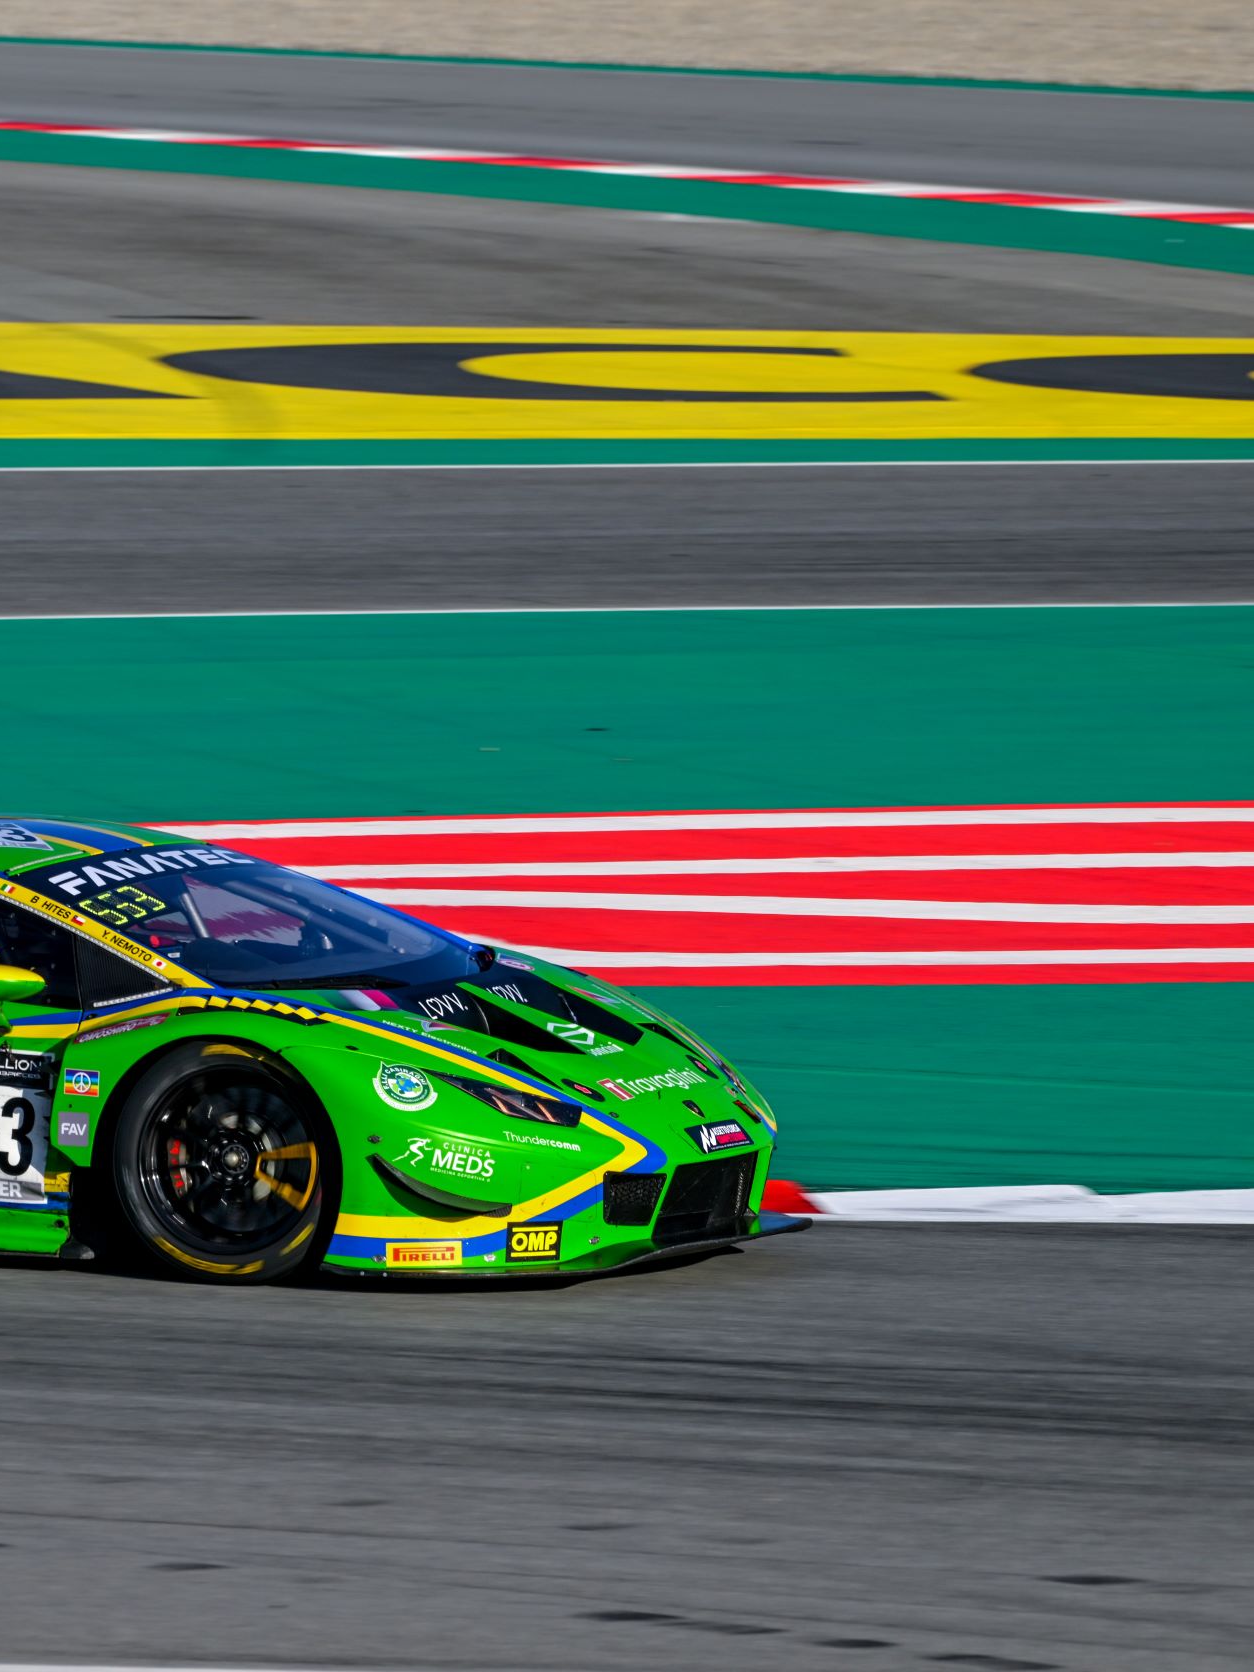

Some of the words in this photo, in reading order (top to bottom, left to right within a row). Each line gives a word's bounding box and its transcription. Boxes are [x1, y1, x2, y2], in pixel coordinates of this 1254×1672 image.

[48, 849, 256, 896] FANATEC
[41, 900, 72, 920] HITES
[101, 929, 112, 939] Y.
[111, 933, 153, 962] NEMOTO
[382, 1019, 419, 1034] NEXTY
[421, 1031, 478, 1055] Electronics
[615, 1067, 707, 1095] Travaglini
[60, 1122, 87, 1136] FAV
[443, 1142, 491, 1158] CLINICA
[502, 1130, 582, 1152] Thundercomm
[431, 1149, 495, 1177] MEDS
[511, 1231, 558, 1251] OMP
[392, 1246, 456, 1262] PIRELLI
